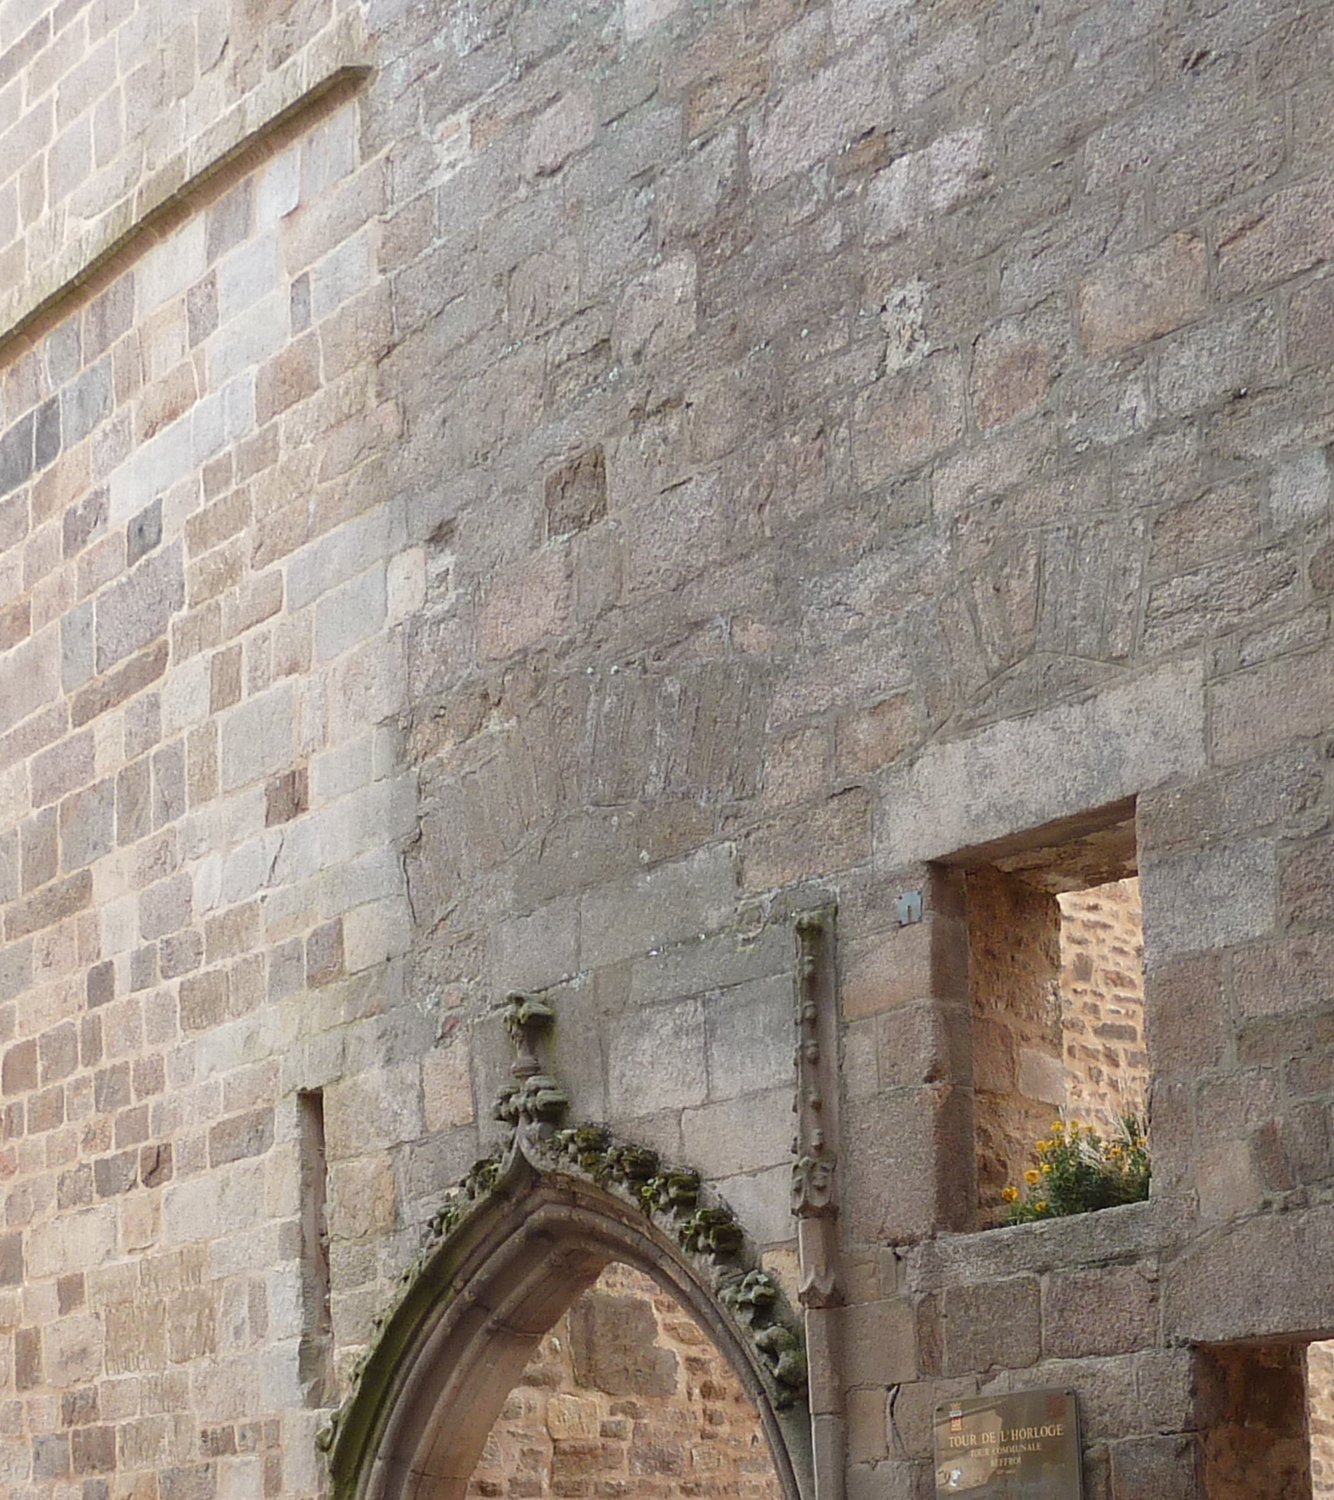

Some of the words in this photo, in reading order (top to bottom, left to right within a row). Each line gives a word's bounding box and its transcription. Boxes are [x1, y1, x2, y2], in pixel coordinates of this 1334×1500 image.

[948, 1434, 977, 1448] TOUR
[982, 1431, 996, 1444] DE
[1001, 1424, 1064, 1442] L'HORLOGE
[992, 1441, 1042, 1455] COMMUNALE
